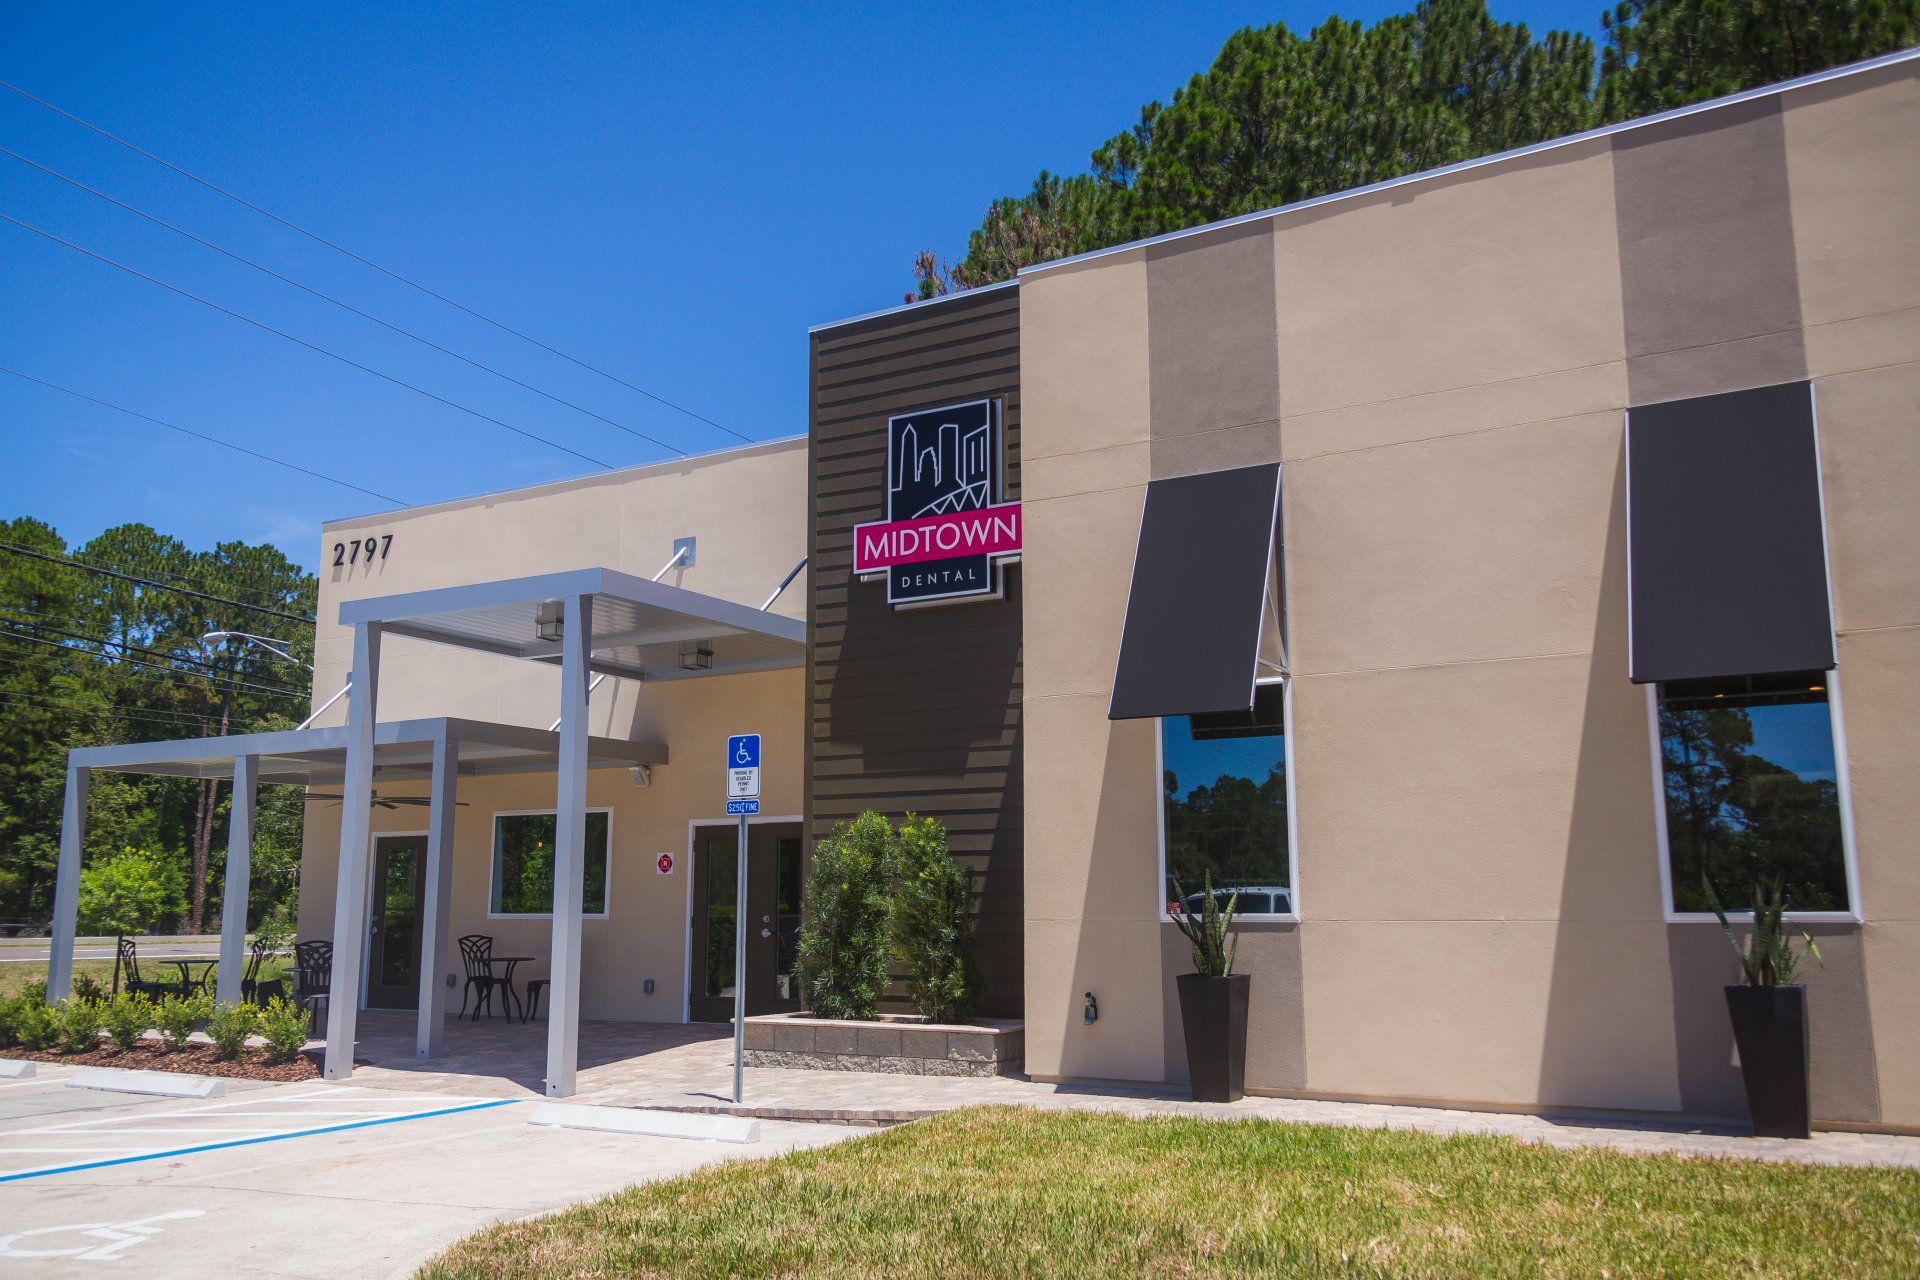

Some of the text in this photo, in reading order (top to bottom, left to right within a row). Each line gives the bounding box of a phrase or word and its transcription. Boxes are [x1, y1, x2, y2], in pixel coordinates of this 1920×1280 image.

[333, 534, 394, 567] 2797
[864, 514, 1017, 561] MIDTOWN
[902, 568, 976, 588] DENTAL
[745, 802, 758, 811] FINE
